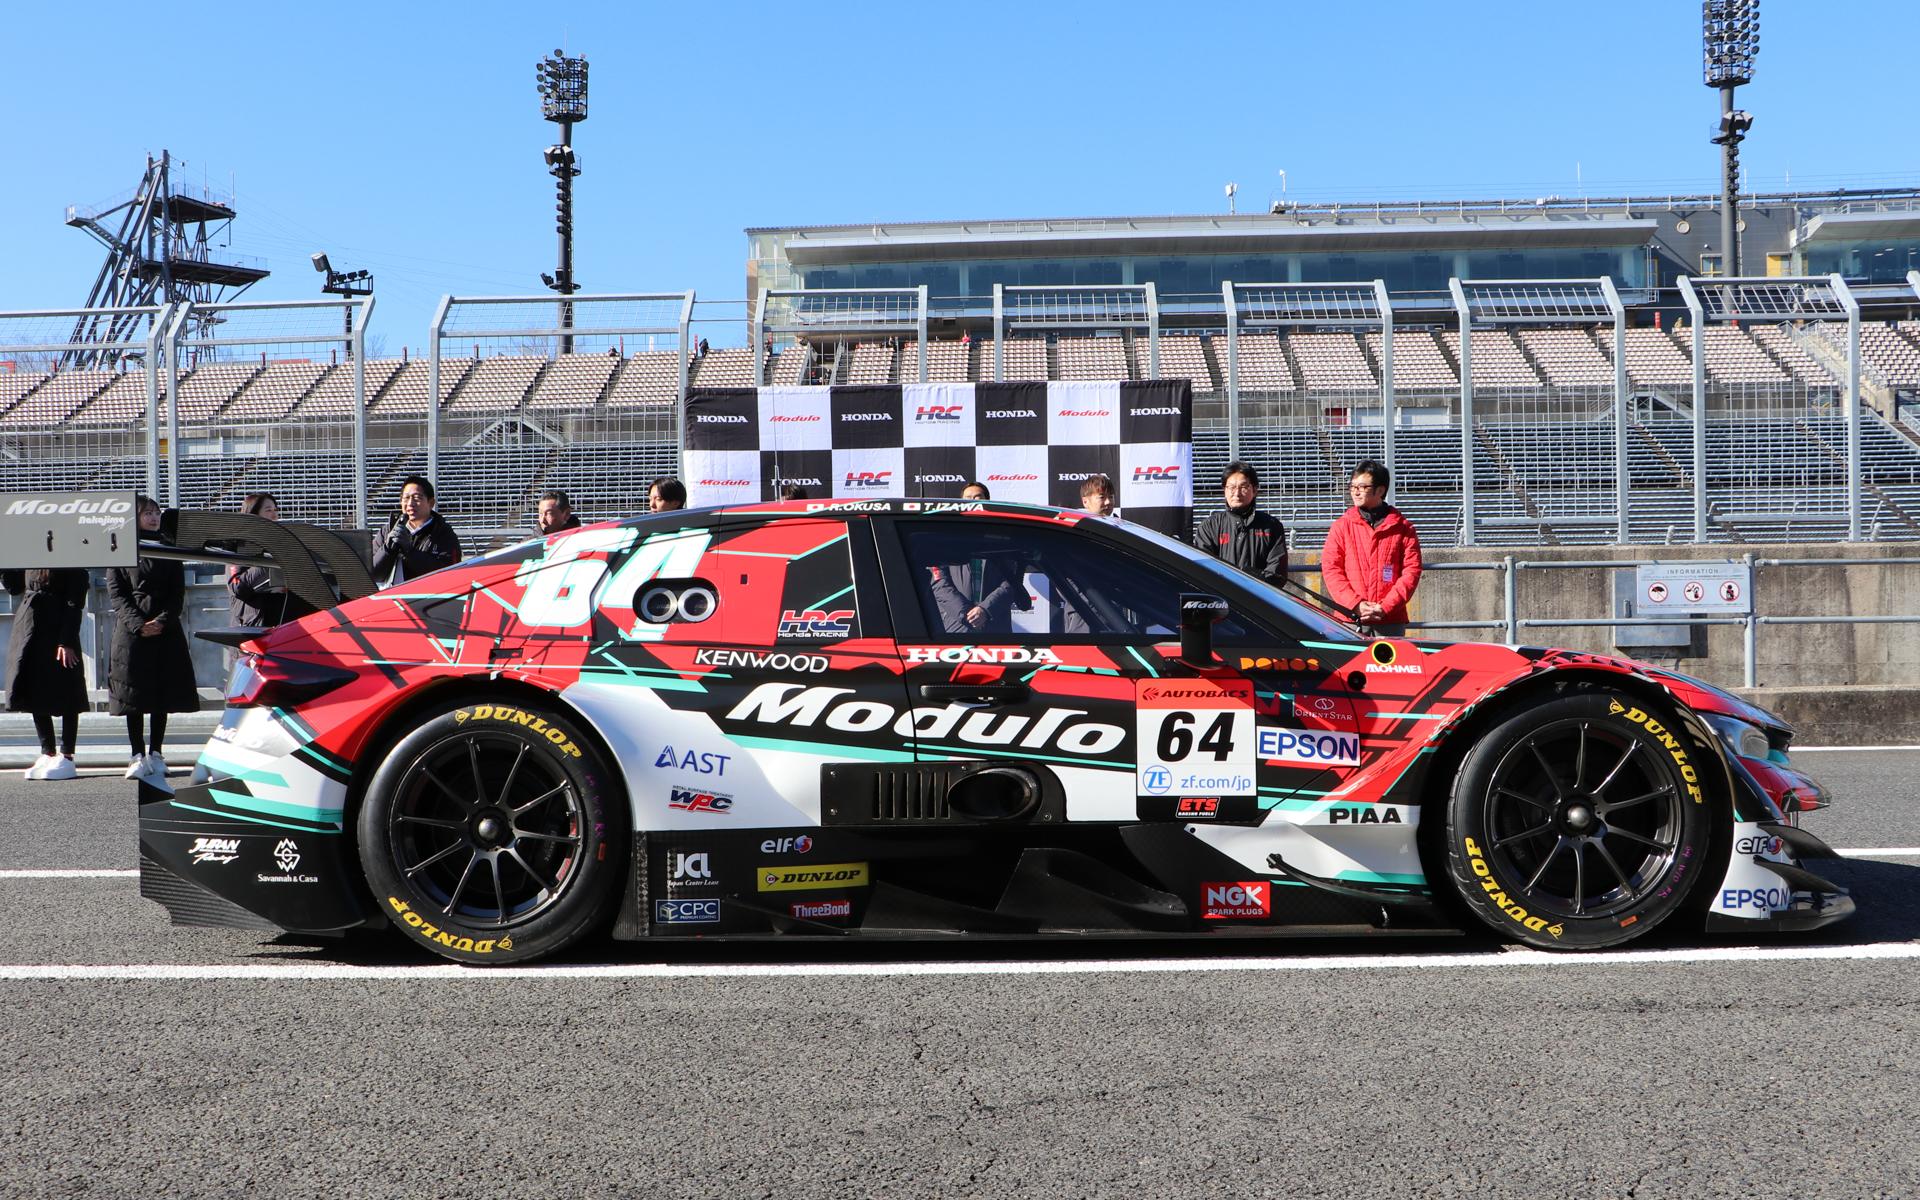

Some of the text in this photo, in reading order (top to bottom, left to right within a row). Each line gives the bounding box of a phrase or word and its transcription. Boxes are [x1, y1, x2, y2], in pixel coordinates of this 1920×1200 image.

[697, 415, 748, 423] HONDA
[841, 412, 893, 421] HONDA
[915, 406, 963, 420] HRC
[985, 410, 1037, 418] HONDA
[1058, 409, 1110, 417] Modulo
[1130, 407, 1182, 416] HONDA
[844, 472, 892, 487] HRC
[987, 473, 1038, 481] Modulo
[1132, 466, 1180, 481] HRC
[5, 498, 132, 515] Modulo
[829, 502, 984, 512] R.OKUSA T.IZAWA
[78, 515, 125, 526] Nakajima
[1183, 601, 1228, 609] Modulo
[777, 610, 855, 632] HRC
[694, 649, 829, 674] KENWOOD
[907, 648, 1063, 663] HONDA
[1240, 657, 1320, 671] PONOS
[1161, 690, 1248, 698] AUTOBACS
[725, 682, 1127, 754] Modulo
[471, 706, 582, 759] DUNLOP
[1157, 711, 1235, 762] 64
[1259, 731, 1358, 761] EPSON
[1624, 706, 1703, 804] DUNLOP
[1147, 772, 1251, 791] ZF zf.com/jp
[1180, 799, 1218, 811] ETS
[1329, 808, 1401, 824] PIAA
[760, 838, 793, 853] elf
[1736, 836, 1769, 854] elf
[257, 873, 292, 882] Savannah
[299, 874, 318, 882] Casa
[781, 870, 861, 883] DUNLOP
[1465, 837, 1549, 932] DUNLOP
[1208, 886, 1263, 906] NGK
[1723, 888, 1788, 908] EPSON
[680, 903, 717, 915] CPC
[793, 902, 850, 917] ThreeBond
[389, 897, 497, 953] DUNLOP
